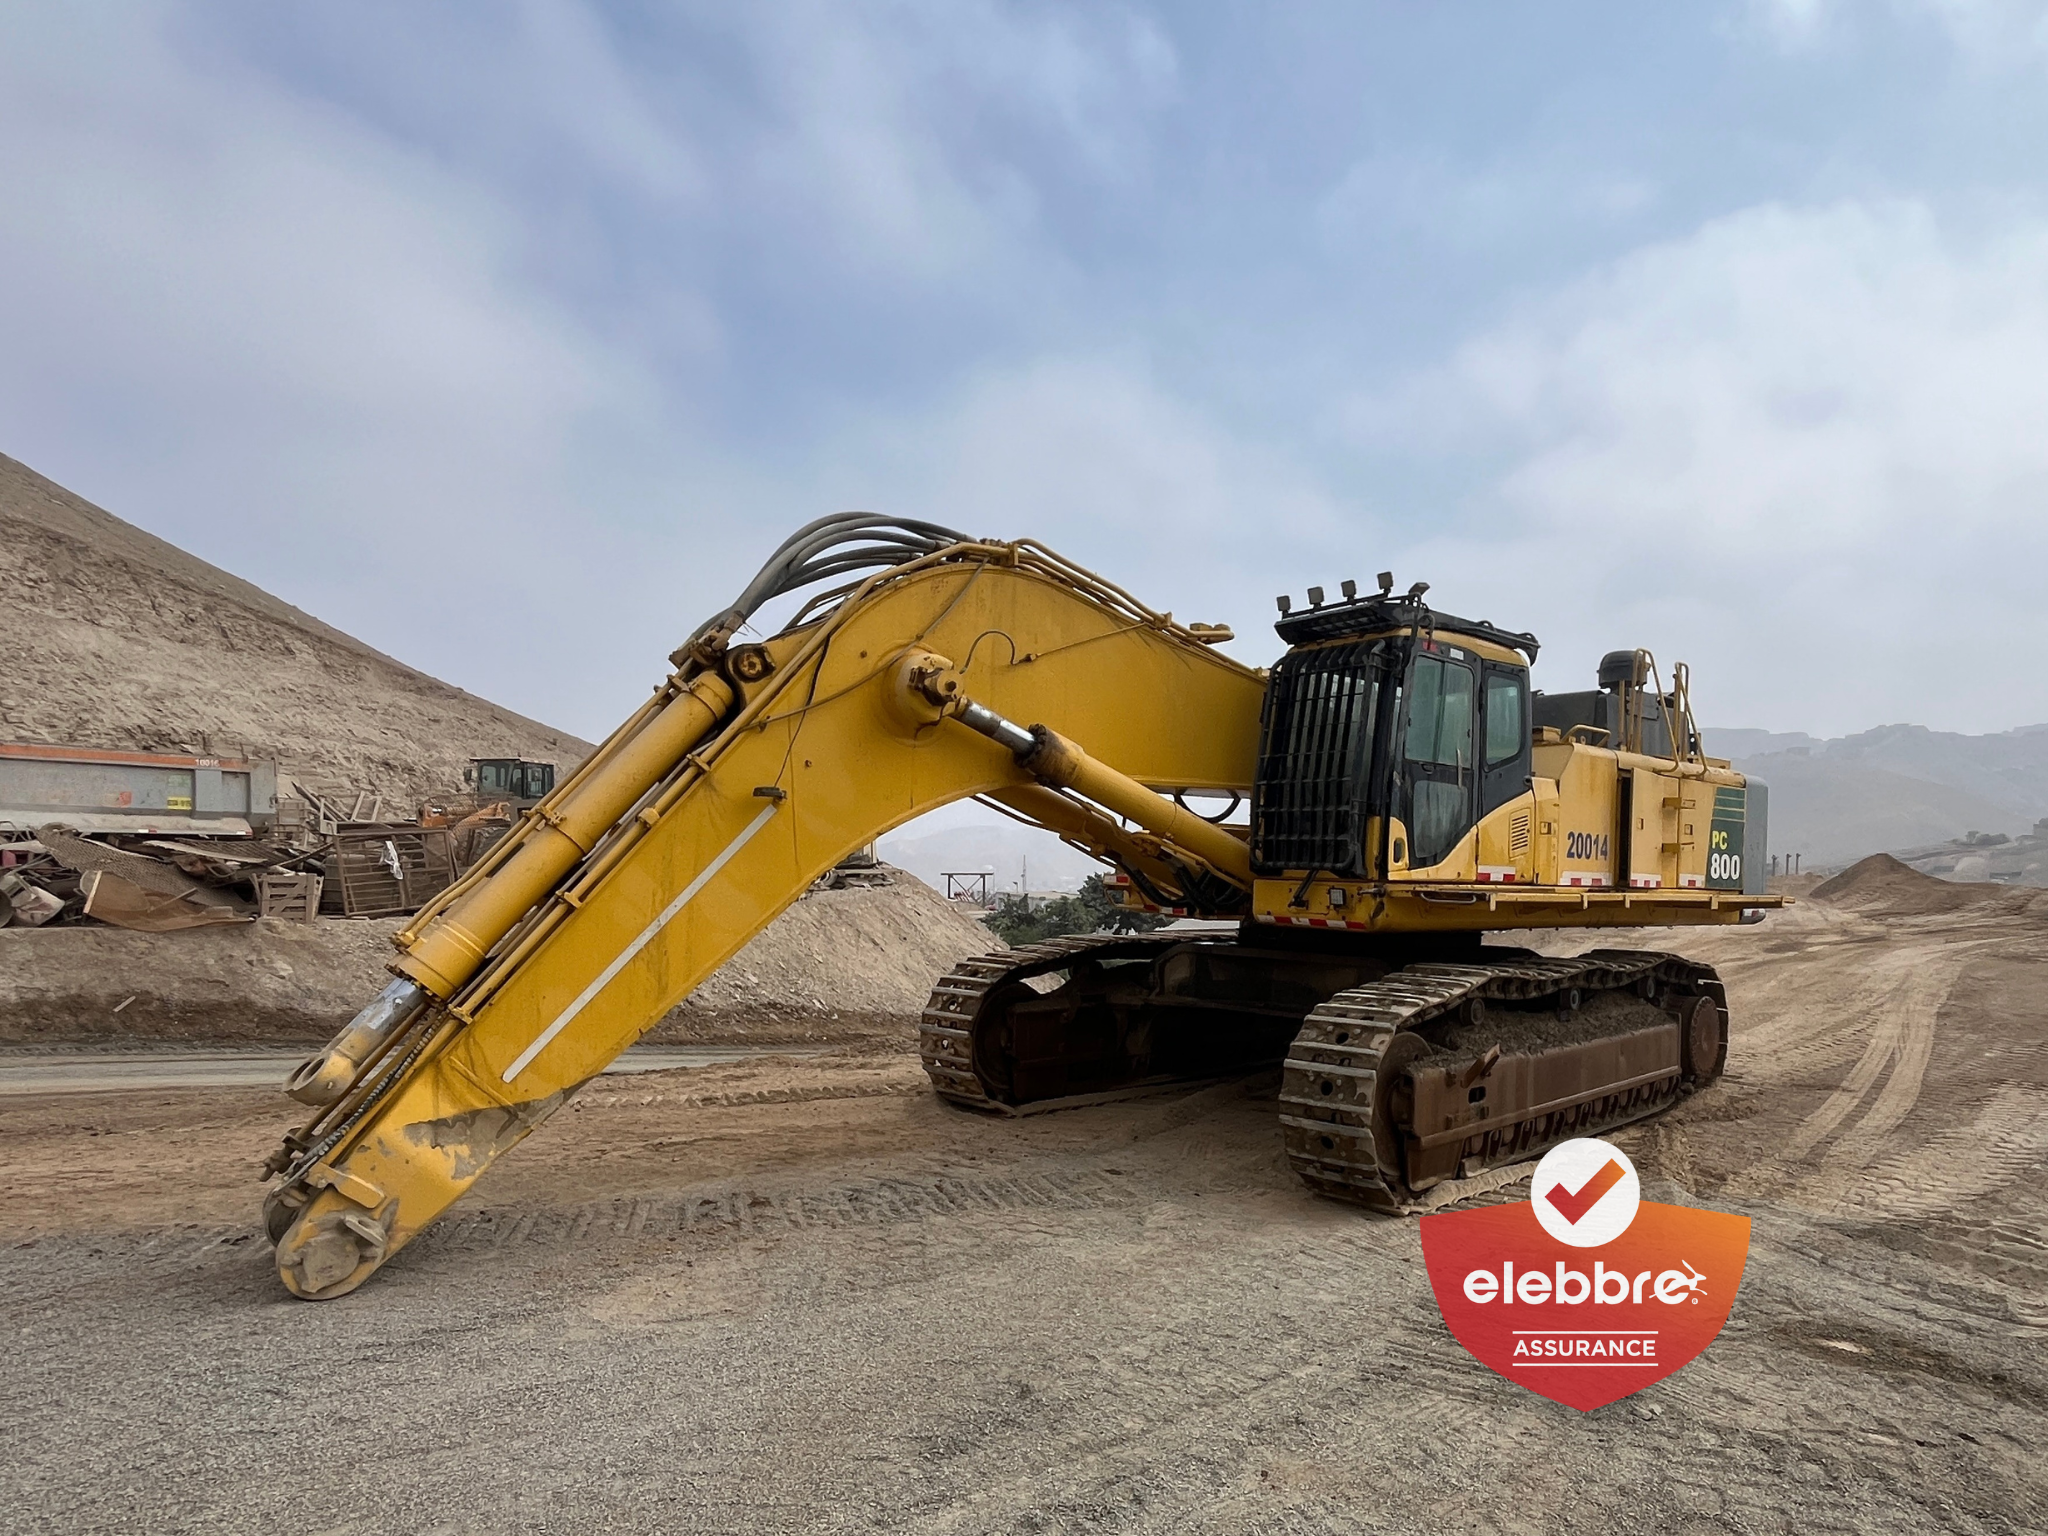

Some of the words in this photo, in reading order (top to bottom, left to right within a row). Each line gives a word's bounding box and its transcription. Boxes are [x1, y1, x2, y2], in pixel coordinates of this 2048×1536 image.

[1566, 831, 1609, 861] 20014
[1711, 830, 1728, 850] PC
[1710, 853, 1741, 880] 800
